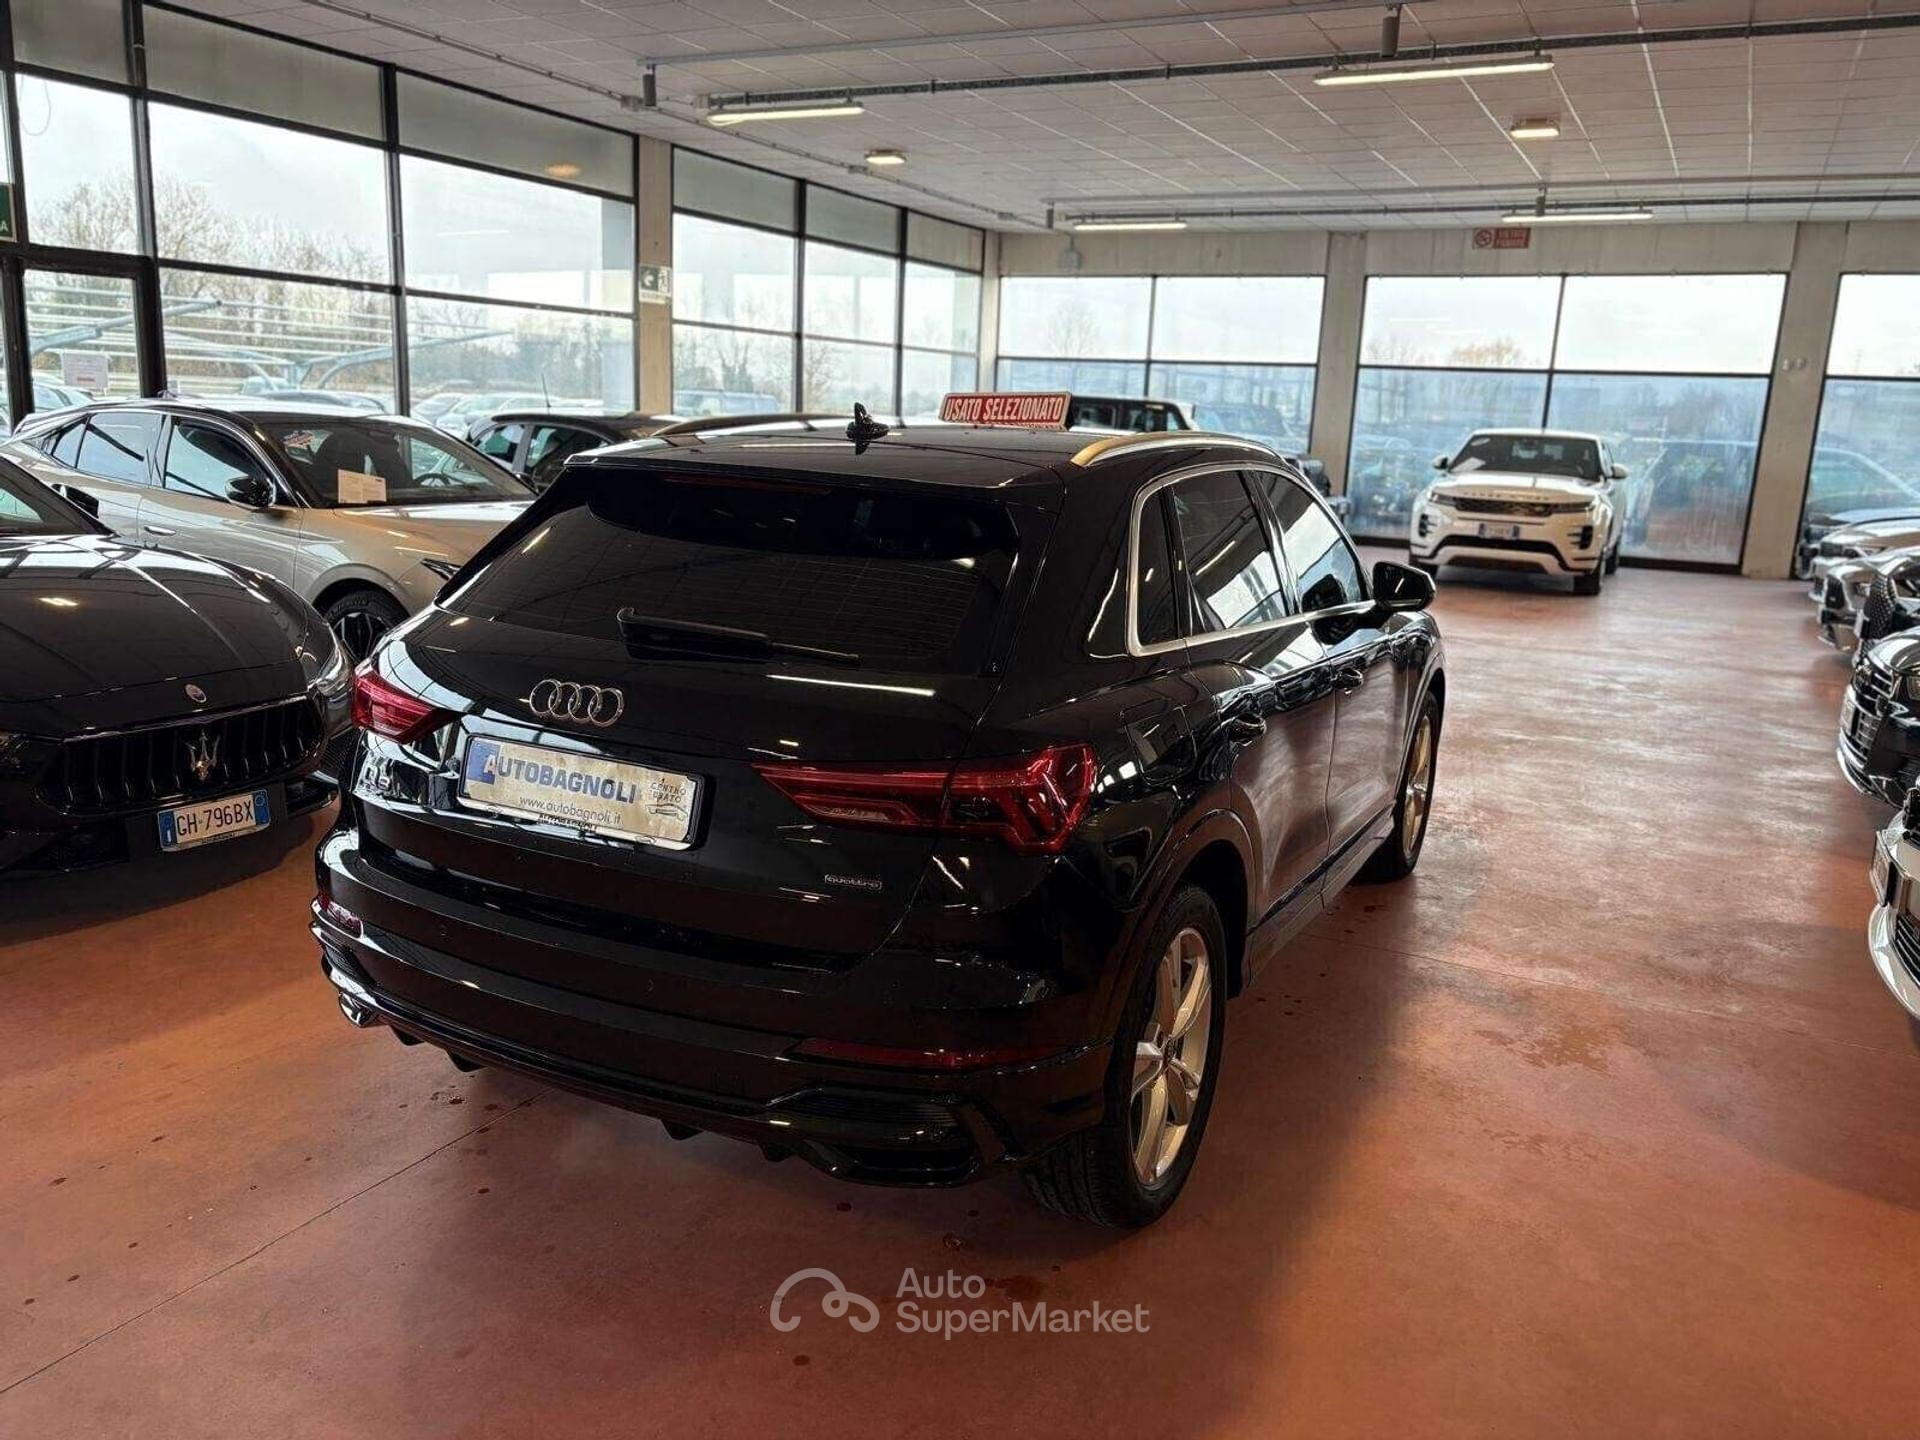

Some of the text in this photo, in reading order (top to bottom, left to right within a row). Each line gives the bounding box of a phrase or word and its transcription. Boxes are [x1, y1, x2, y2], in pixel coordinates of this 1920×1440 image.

[943, 397, 1063, 421] USATO SELEZIONATO
[482, 753, 637, 804] AUTOBAGNOLI
[519, 796, 621, 826] www.autobagnoli.it
